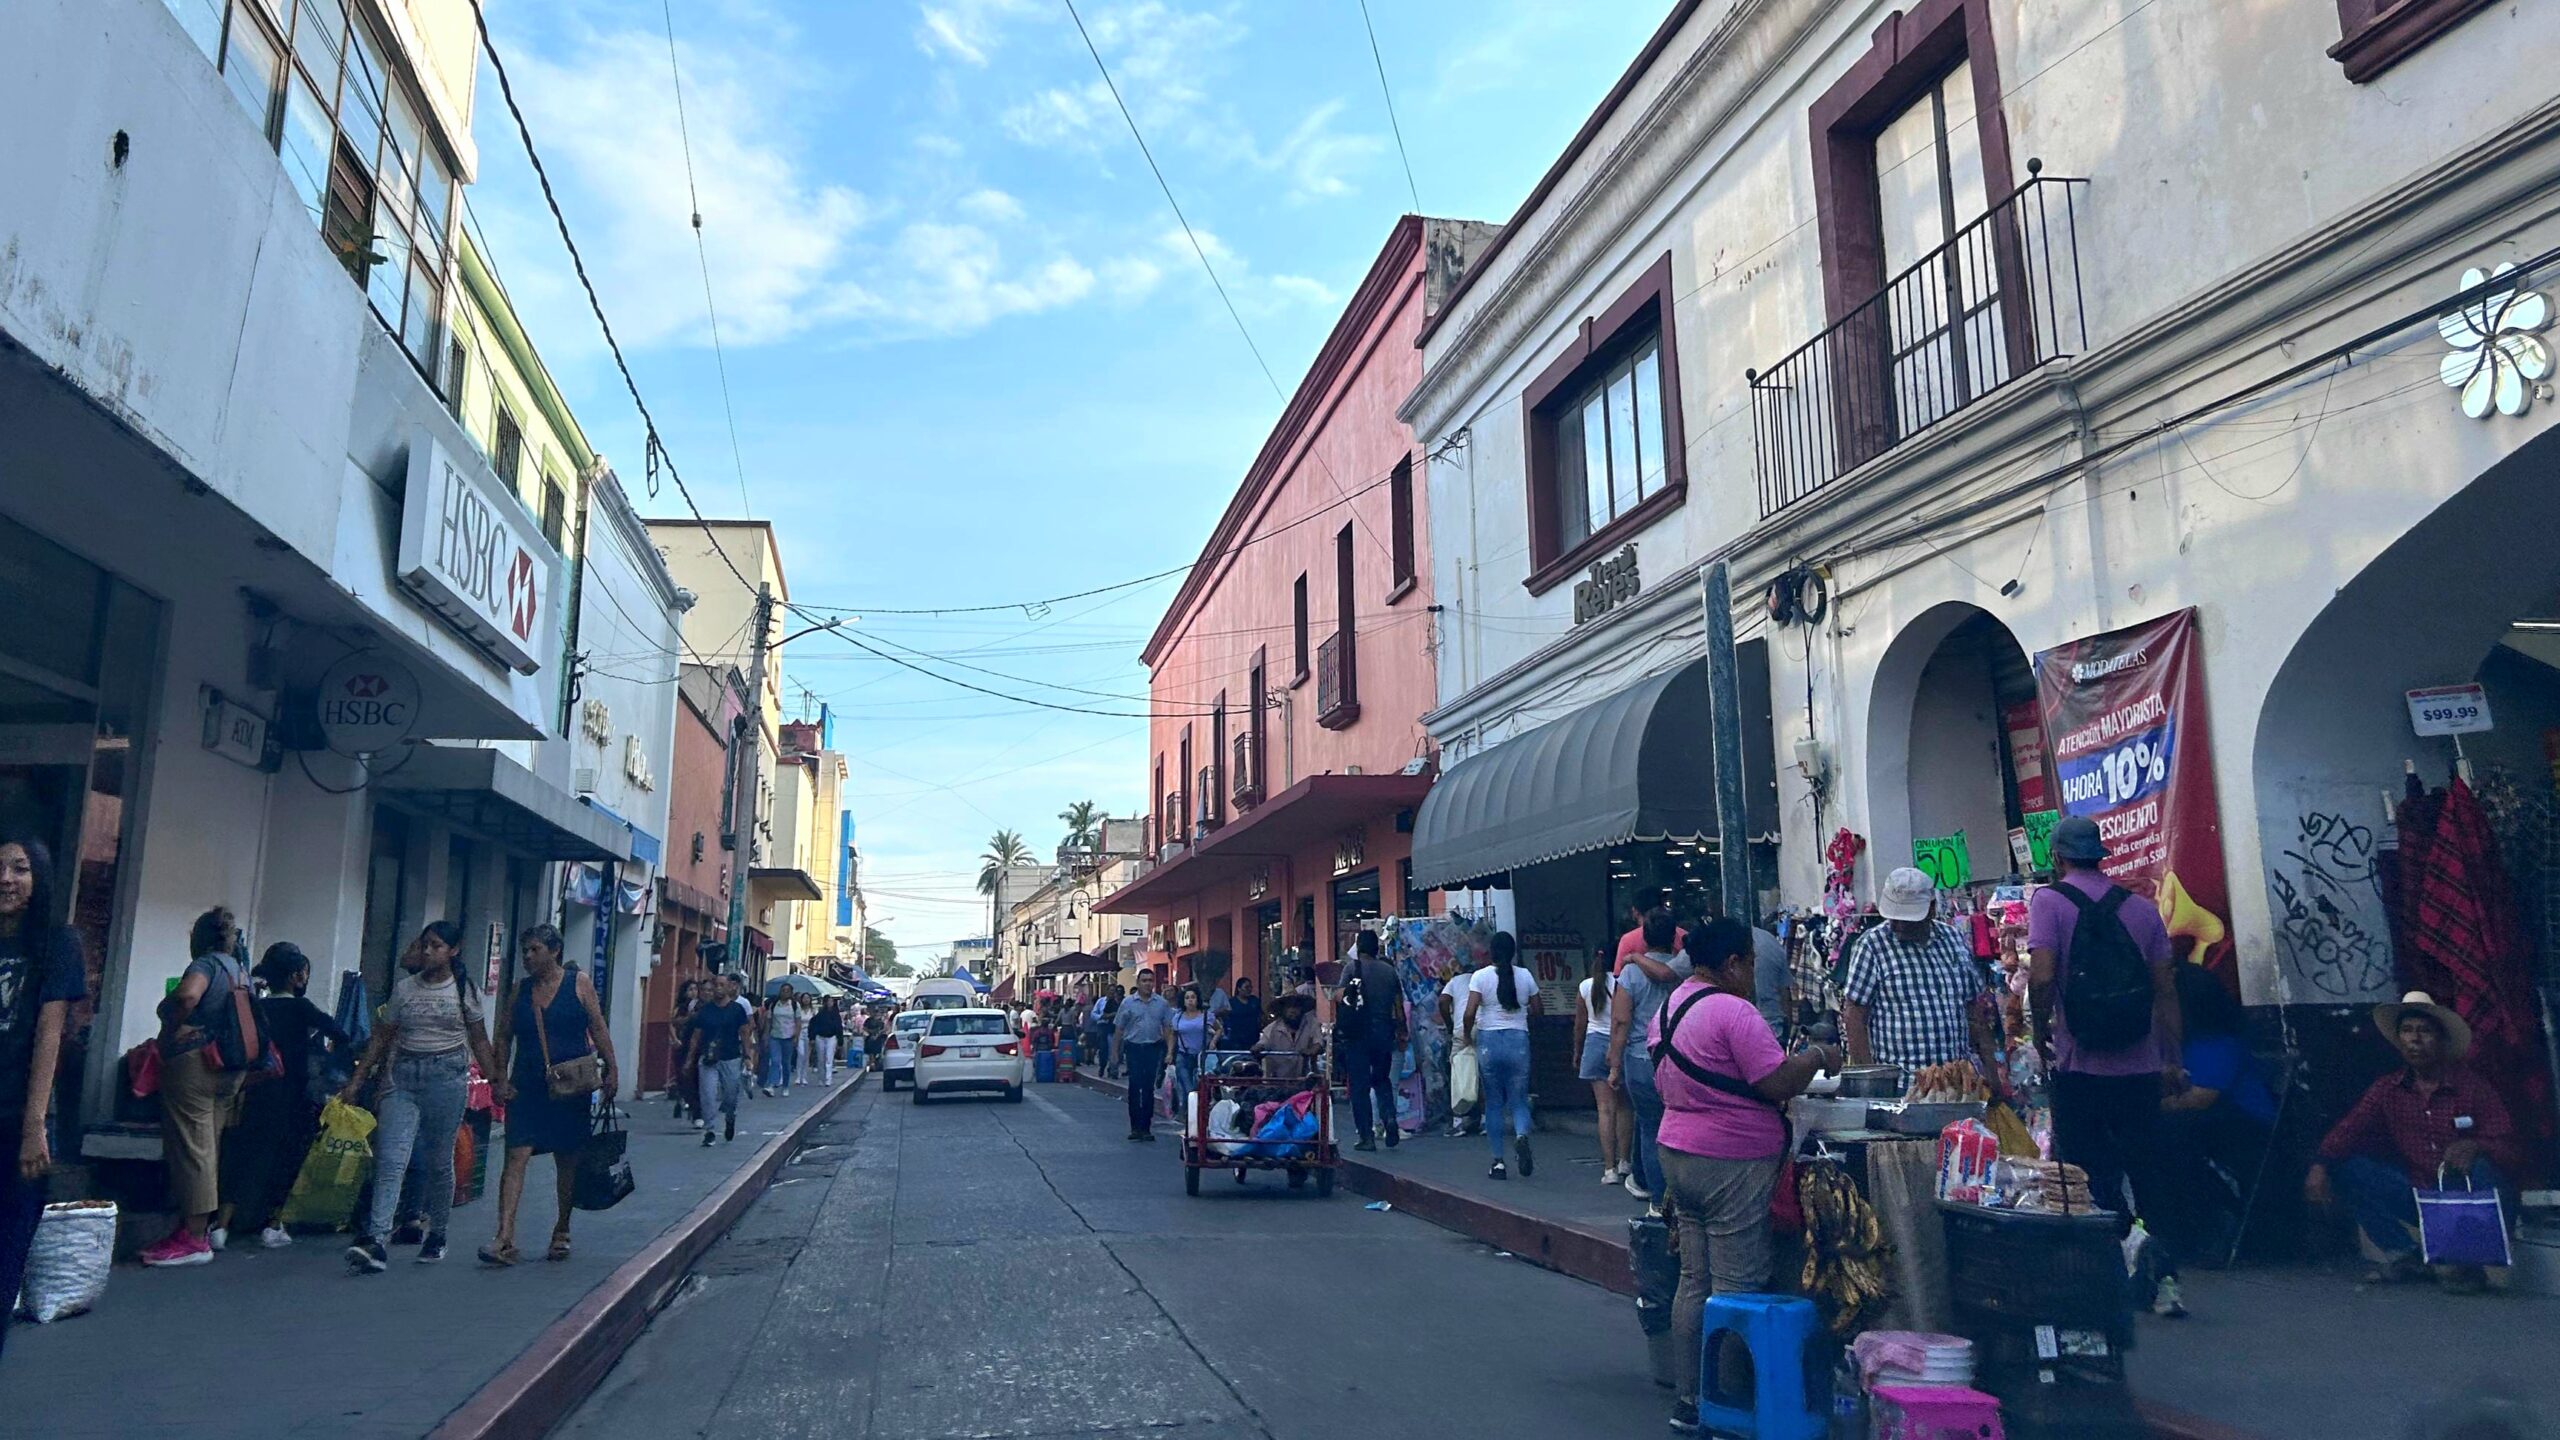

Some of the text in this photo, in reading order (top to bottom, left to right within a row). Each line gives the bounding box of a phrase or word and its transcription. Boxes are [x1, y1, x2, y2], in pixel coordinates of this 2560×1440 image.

[434, 460, 508, 618] HSBC
[1588, 557, 1619, 589] Tres
[1574, 567, 1641, 625] Reyes
[2083, 648, 2148, 680] MODATELAS
[325, 700, 405, 726] HSBC
[2101, 692, 2166, 740] MAYORISTA
[2423, 706, 2478, 722] $99.99
[231, 715, 256, 748] ATM
[2063, 742, 2166, 805] AHORA 10%
[2096, 801, 2159, 842] ESCUENTO
[2113, 843, 2130, 857] tela
[1917, 847, 1960, 889] 50
[1524, 933, 1581, 945] OFERTAS
[1536, 951, 1572, 981] 10%
